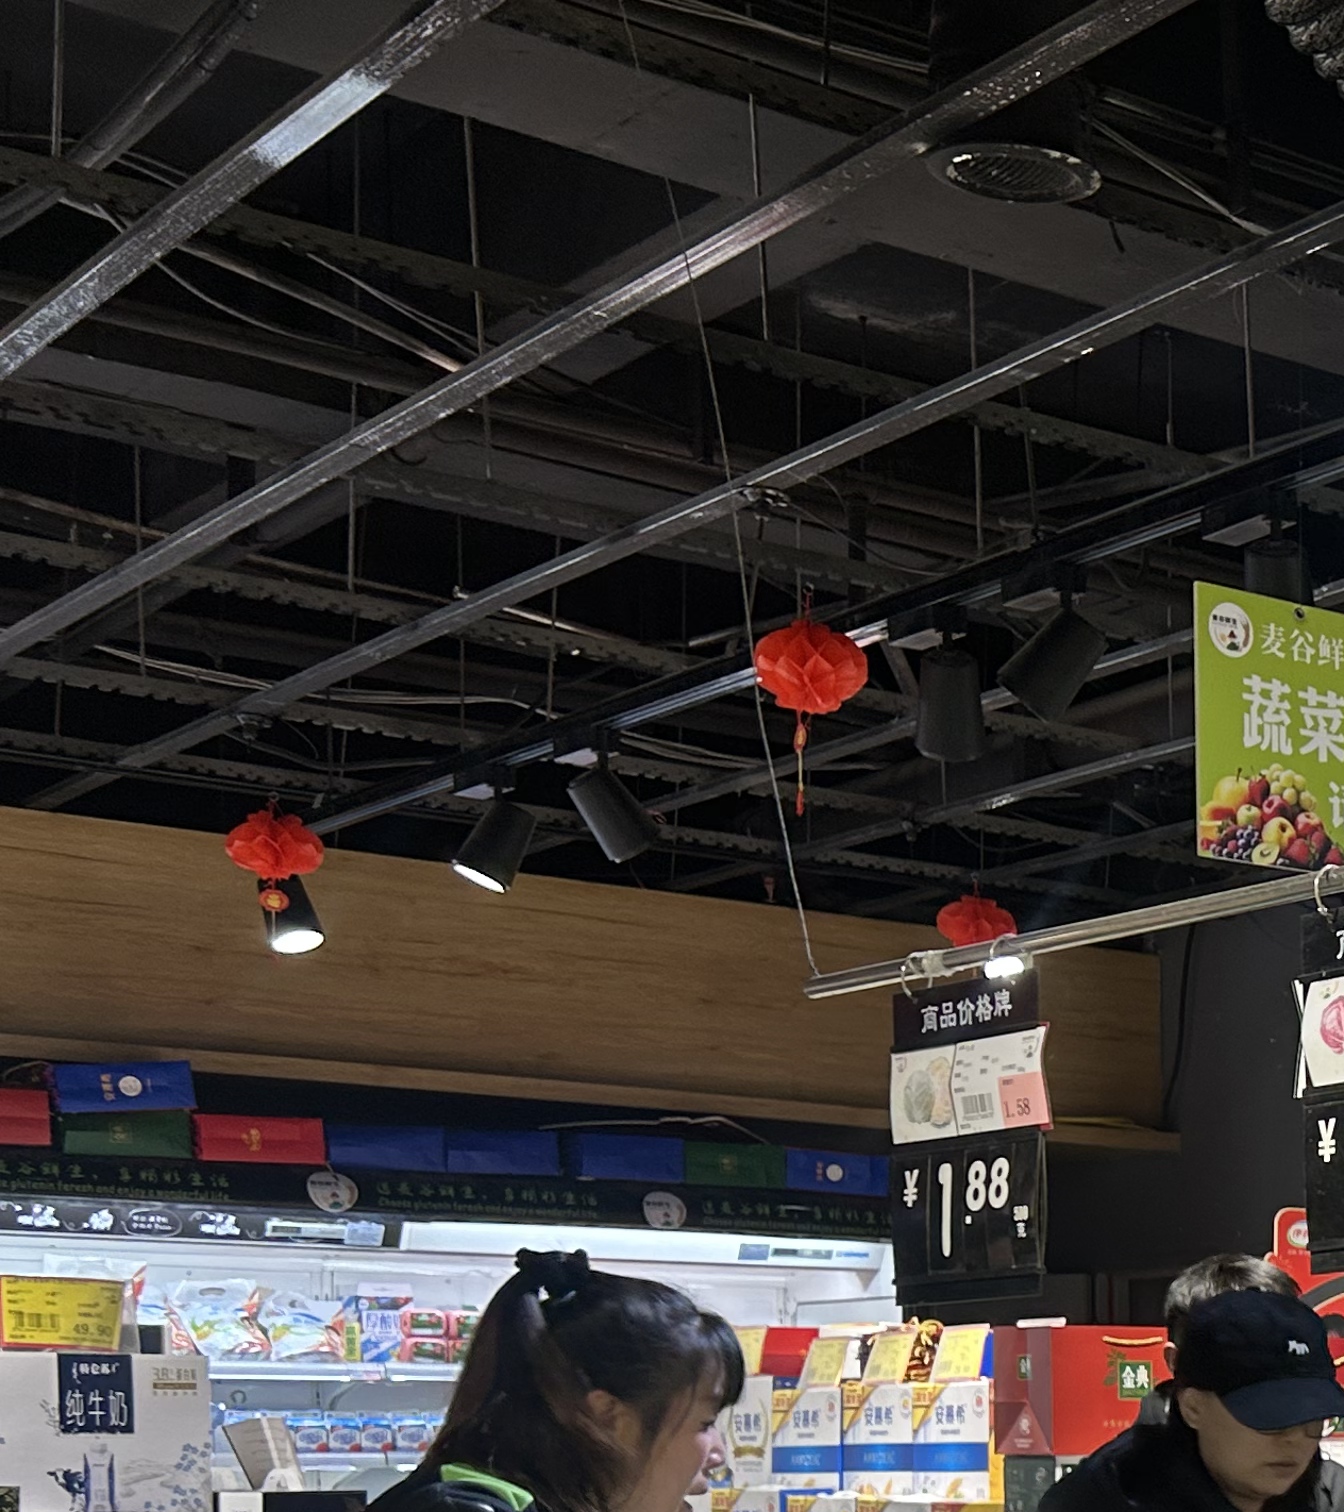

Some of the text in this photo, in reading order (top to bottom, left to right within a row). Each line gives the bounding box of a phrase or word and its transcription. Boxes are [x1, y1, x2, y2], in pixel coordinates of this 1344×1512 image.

[921, 988, 1013, 1034] 商品价格牌
[1317, 1116, 1337, 1163] ¥
[903, 1168, 920, 1208] ¥
[938, 1156, 1010, 1258] 1.88
[1121, 1364, 1150, 1390] 金典
[65, 1389, 128, 1427] 纯牛奶
